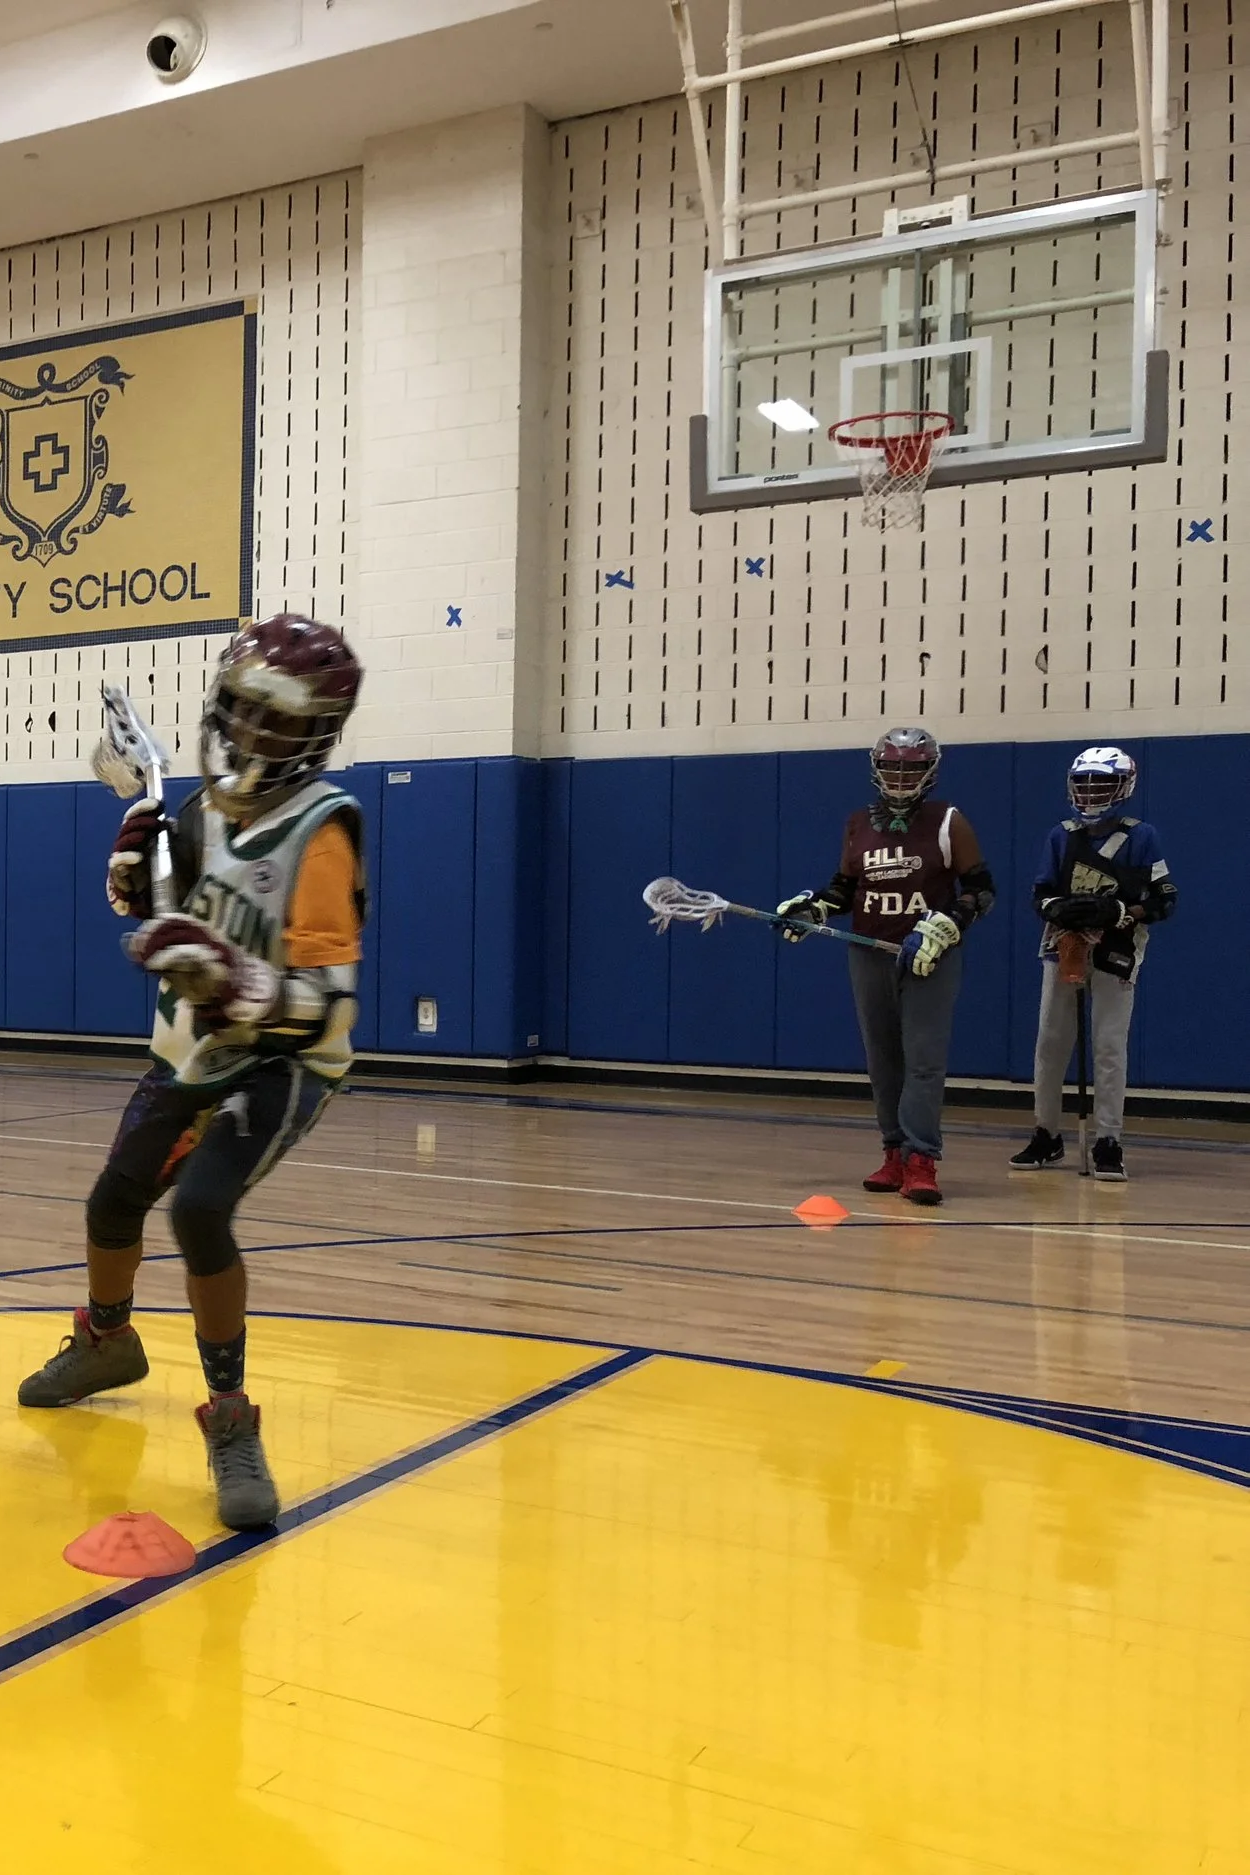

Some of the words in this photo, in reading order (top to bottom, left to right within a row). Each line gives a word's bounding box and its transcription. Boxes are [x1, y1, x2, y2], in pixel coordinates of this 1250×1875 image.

[65, 361, 101, 391] SCHOOL
[79, 526, 90, 534] ET
[91, 486, 112, 528] VIRTUTE
[35, 543, 54, 556] 1709
[49, 562, 210, 613] SCHOOL
[862, 846, 908, 867] HLL
[863, 891, 929, 915] FDA
